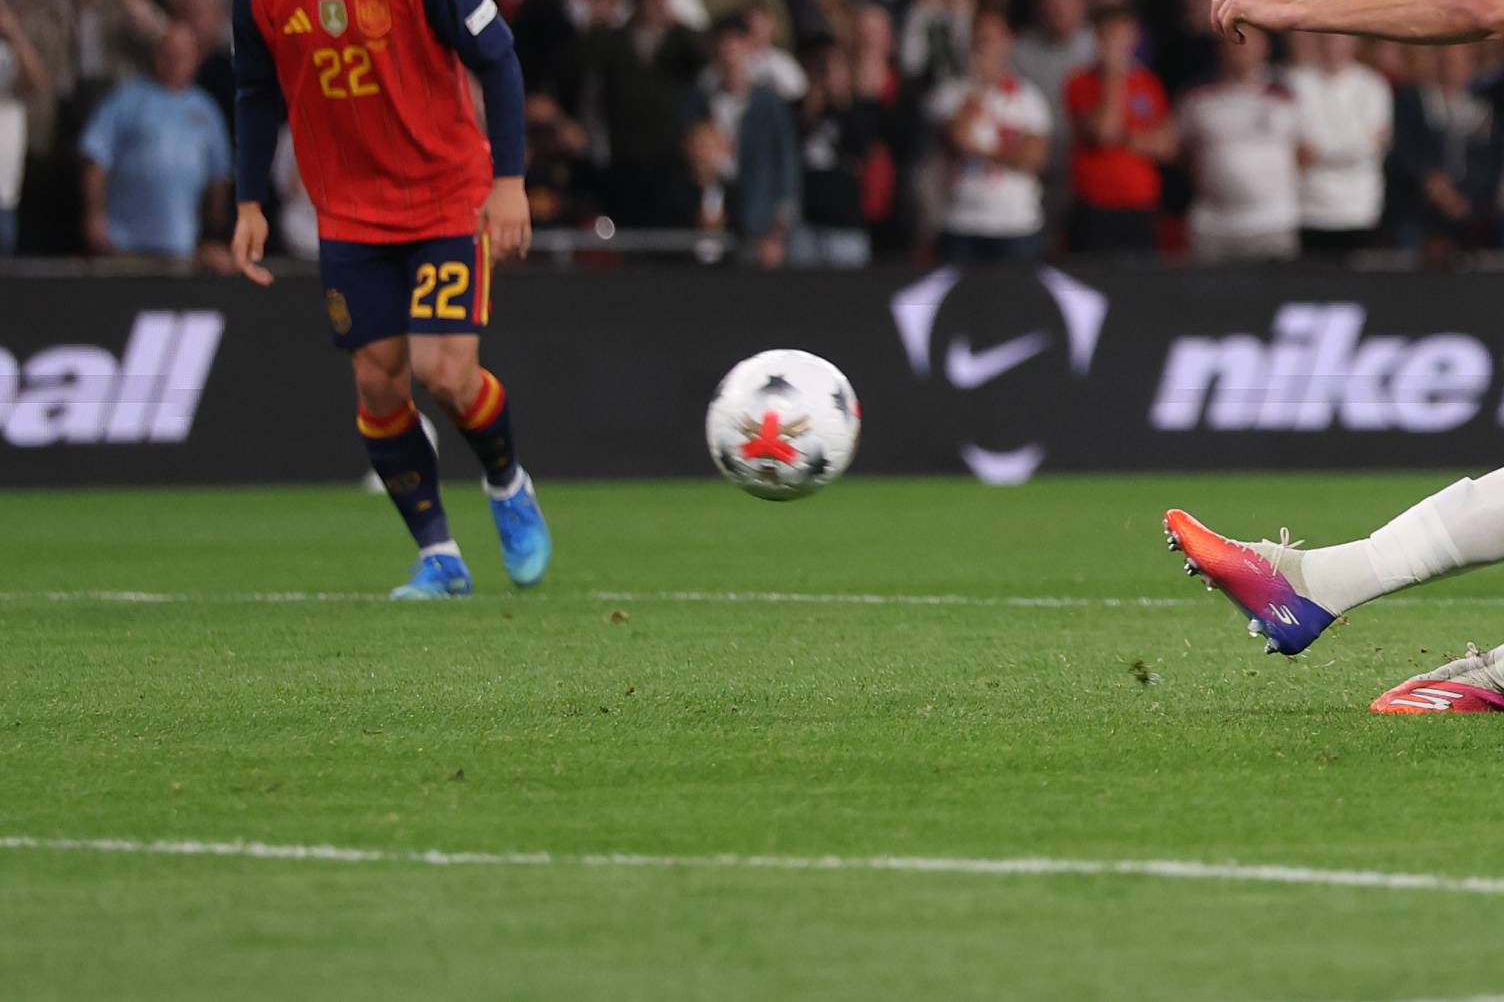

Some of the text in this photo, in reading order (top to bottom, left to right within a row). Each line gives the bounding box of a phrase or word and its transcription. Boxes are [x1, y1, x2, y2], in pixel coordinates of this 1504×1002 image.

[312, 46, 380, 98] 22
[410, 261, 470, 320] 22
[0, 309, 225, 447] all
[1150, 301, 1493, 432] nike
